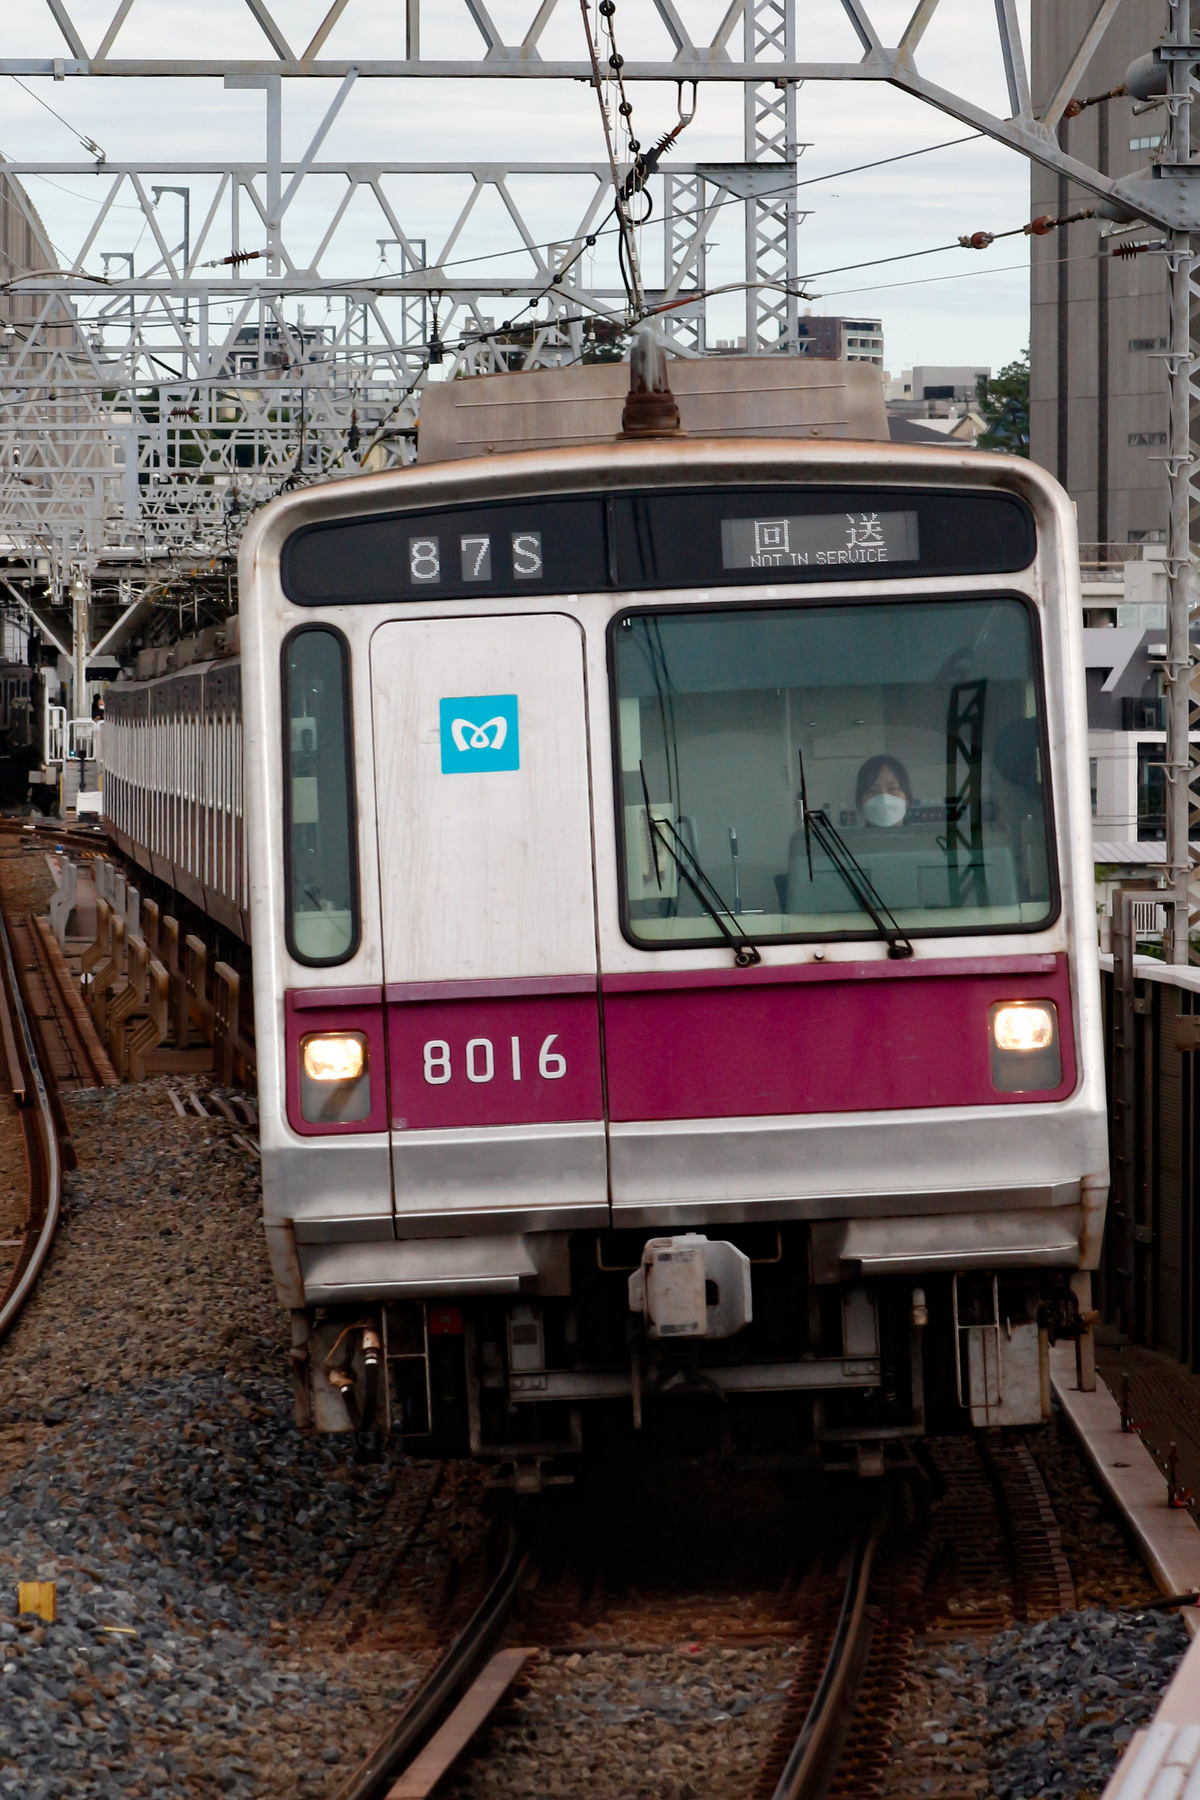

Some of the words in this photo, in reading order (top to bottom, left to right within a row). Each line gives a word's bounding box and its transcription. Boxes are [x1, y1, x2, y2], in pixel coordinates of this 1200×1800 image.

[754, 513, 885, 554] 回送
[750, 554, 783, 568] NOT
[790, 552, 808, 566] IN
[816, 548, 888, 565] SERVICE
[423, 1034, 567, 1085] 8016
